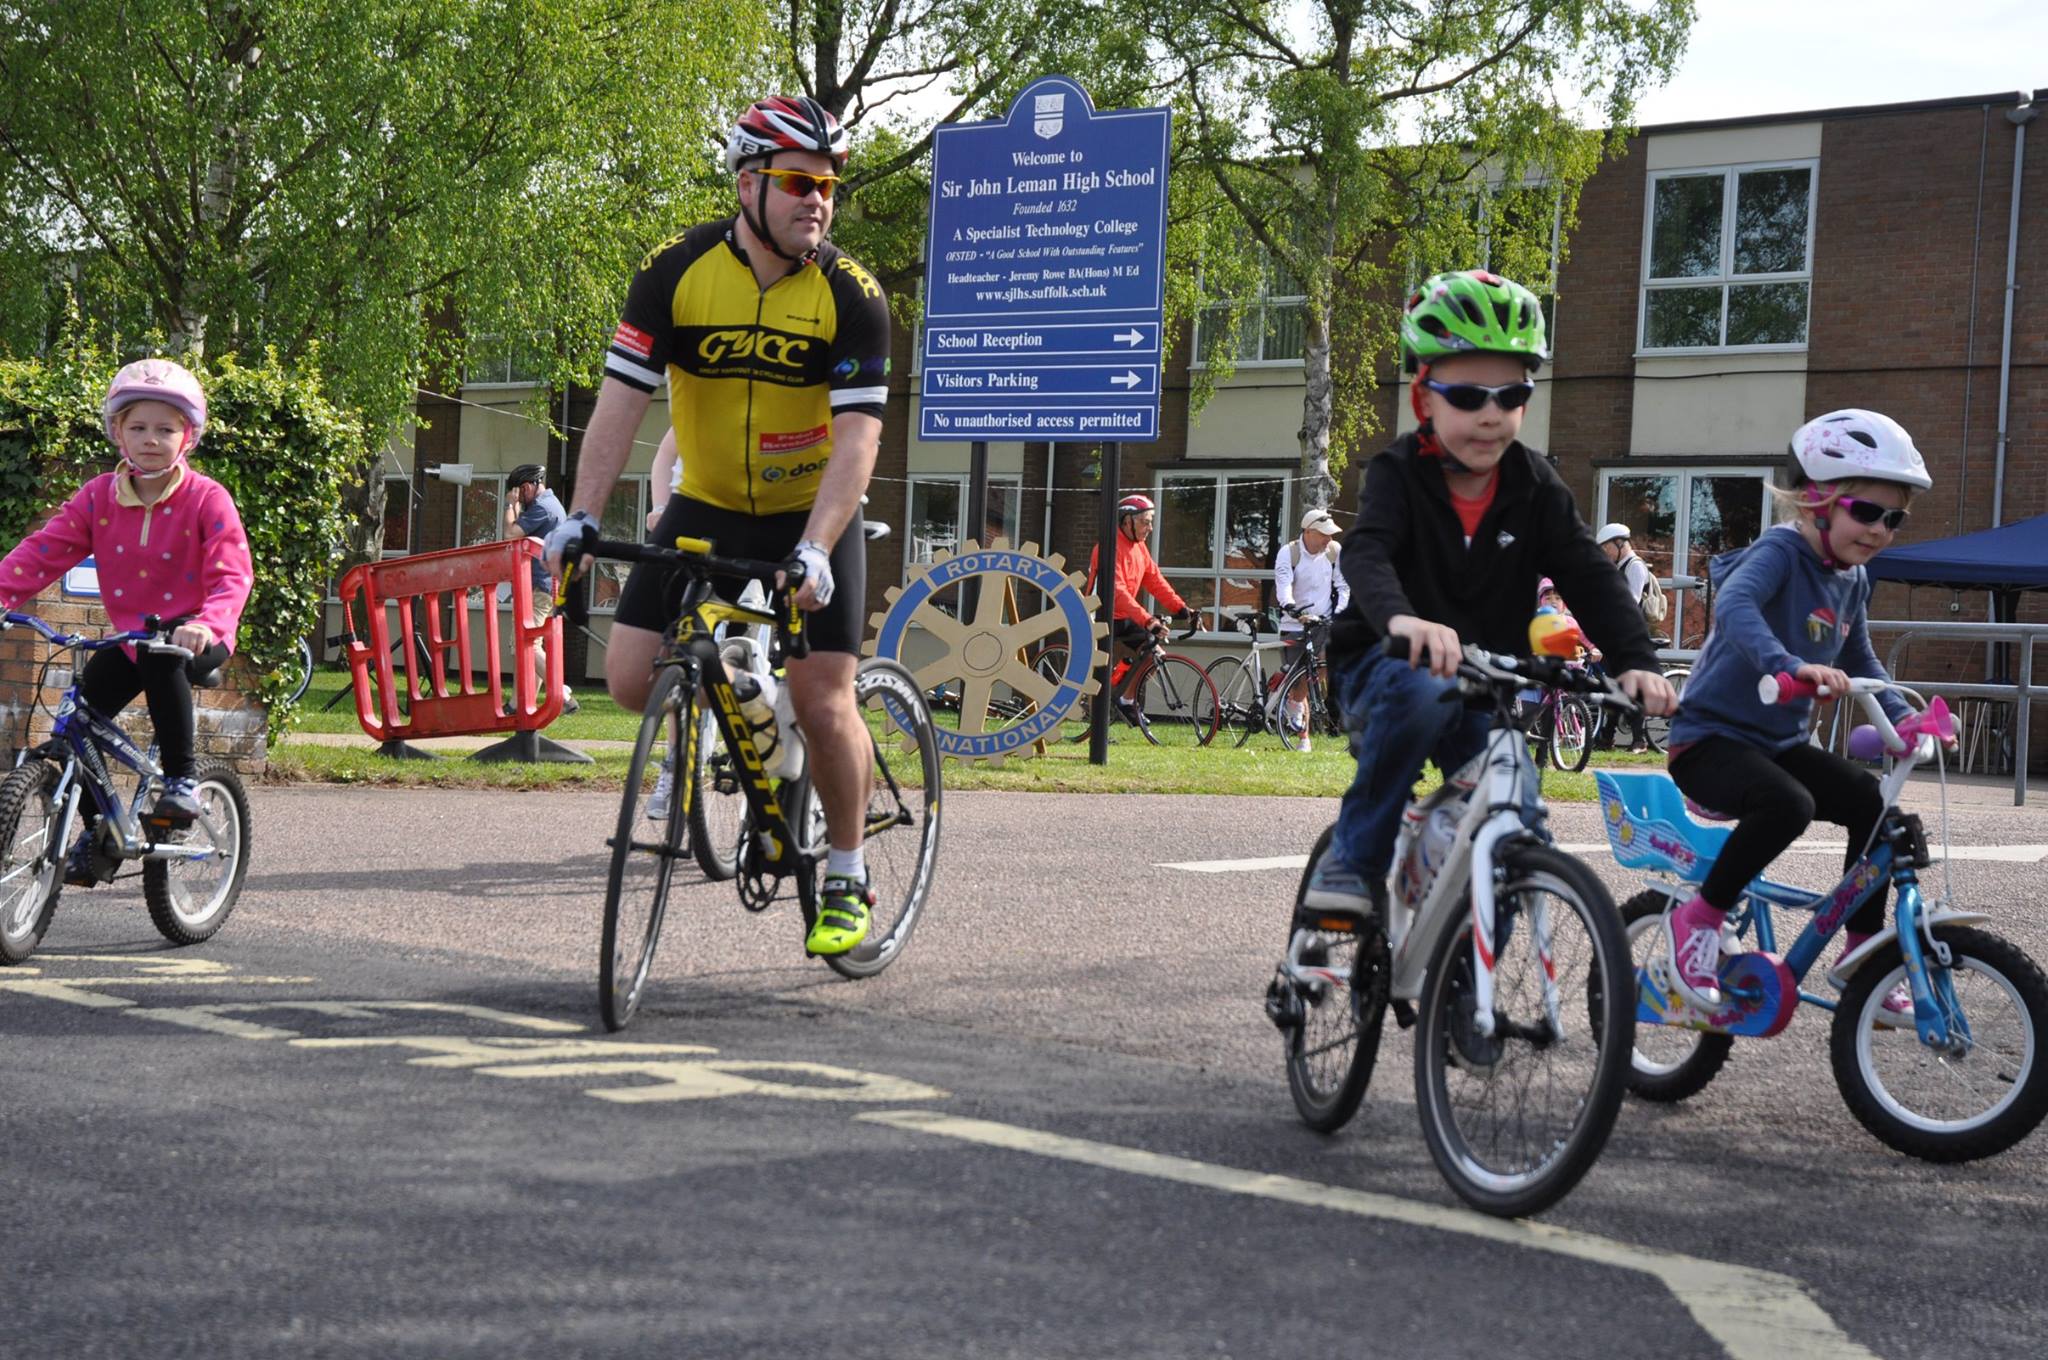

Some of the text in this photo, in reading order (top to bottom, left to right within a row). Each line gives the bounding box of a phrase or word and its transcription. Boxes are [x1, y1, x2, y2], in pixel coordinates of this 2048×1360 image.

[1012, 149, 1083, 167] Welcome to
[941, 168, 1155, 198] Sir John Leman High School
[1013, 199, 1077, 216] Founded 1632
[953, 219, 1139, 243] A Specialist Technology College
[946, 250, 977, 262] OFSTED
[996, 248, 1015, 260] Good
[1017, 247, 1041, 258] School
[1042, 246, 1060, 257] With
[1061, 245, 1105, 257] Outstanding
[948, 272, 1000, 284] Headteacher
[1009, 270, 1040, 283] Jeremy
[1042, 268, 1066, 280] Rowe
[1068, 266, 1110, 280] BA(Hons)
[1112, 265, 1123, 278] M
[1126, 264, 1140, 277] Ed
[976, 284, 1107, 302] www.sjlhs.suffolk.sch.uk
[938, 332, 1043, 349] School Reception
[936, 373, 1039, 390] Visitors Parking
[933, 412, 1142, 430] No unauthorised access permitted
[945, 554, 1051, 580] ROTARY
[887, 698, 1068, 754] INTNATIONAL
[713, 682, 786, 822] SCOTT
